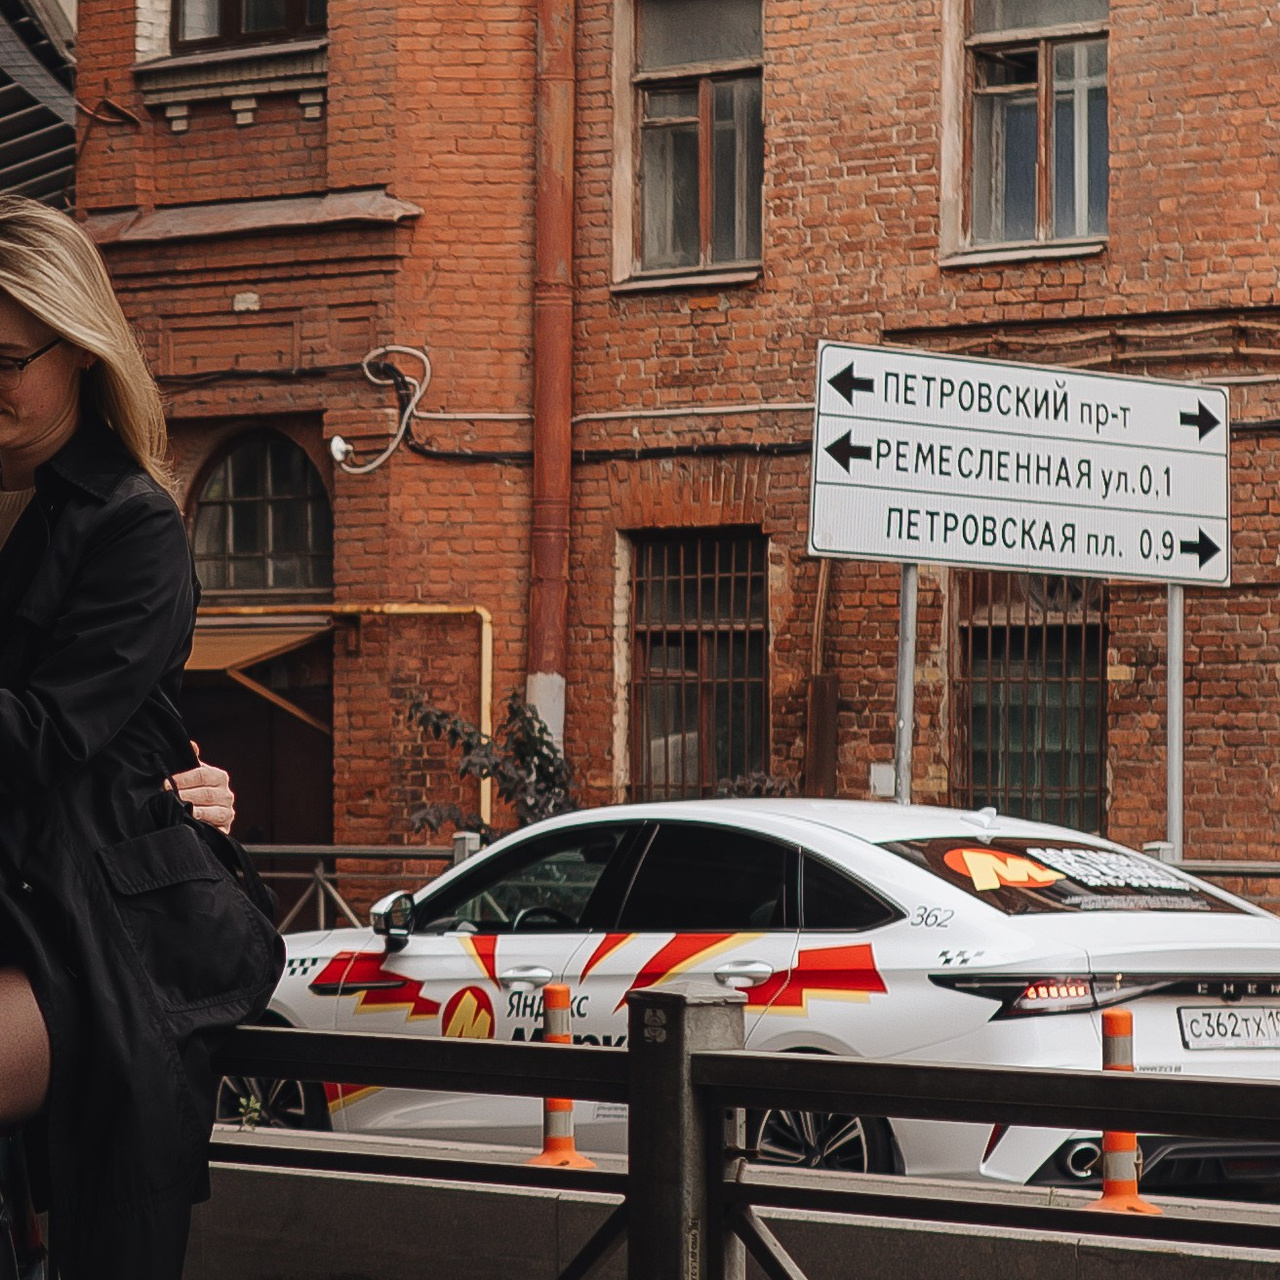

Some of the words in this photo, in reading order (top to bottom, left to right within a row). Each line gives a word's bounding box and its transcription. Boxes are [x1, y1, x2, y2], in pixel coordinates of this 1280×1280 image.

[883, 371, 1069, 423] ПЕТРОВСКИЙ
[1079, 400, 1131, 433] пр-т
[875, 438, 1092, 489] РЕМЕСЛЕННАЯ
[886, 507, 1076, 554] ПЕТРОВСКАЯ
[1086, 532, 1123, 558] пл.
[910, 905, 955, 928] 362
